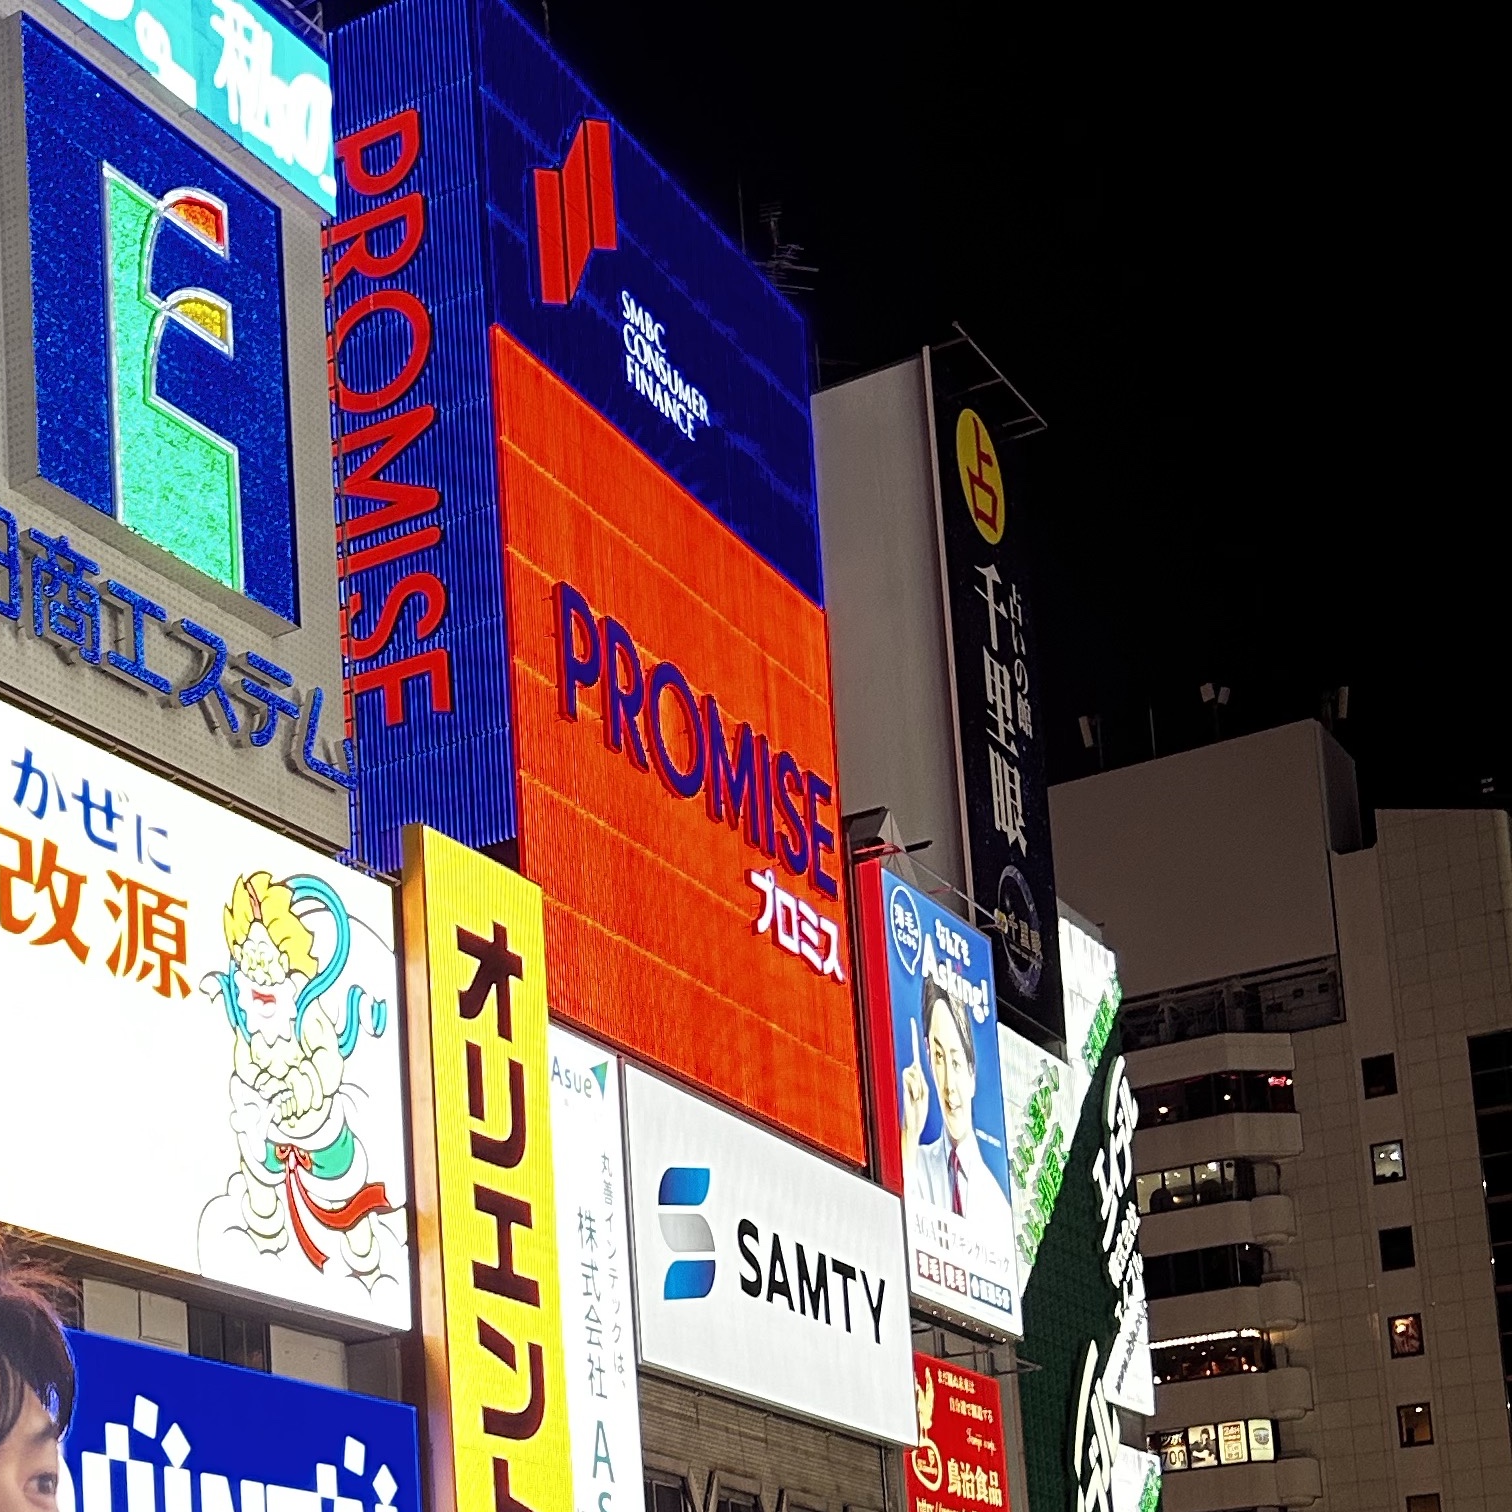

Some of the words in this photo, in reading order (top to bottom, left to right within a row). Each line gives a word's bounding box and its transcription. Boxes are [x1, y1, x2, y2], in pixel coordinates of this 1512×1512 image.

[621, 290, 667, 353] SMBC
[623, 323, 711, 427] CONSUMER
[331, 109, 454, 728] PROMISE
[626, 354, 696, 442] FINANCE
[966, 415, 1000, 535] 占
[552, 580, 839, 902] PROMISE
[974, 563, 1028, 858] 千里眼
[11, 746, 172, 874] かぜに
[746, 868, 845, 984] プロミス
[922, 933, 990, 1024] Asking!
[551, 1055, 593, 1099] Asue
[578, 1207, 608, 1399] 株式会社
[737, 1218, 886, 1345] SAMTY
